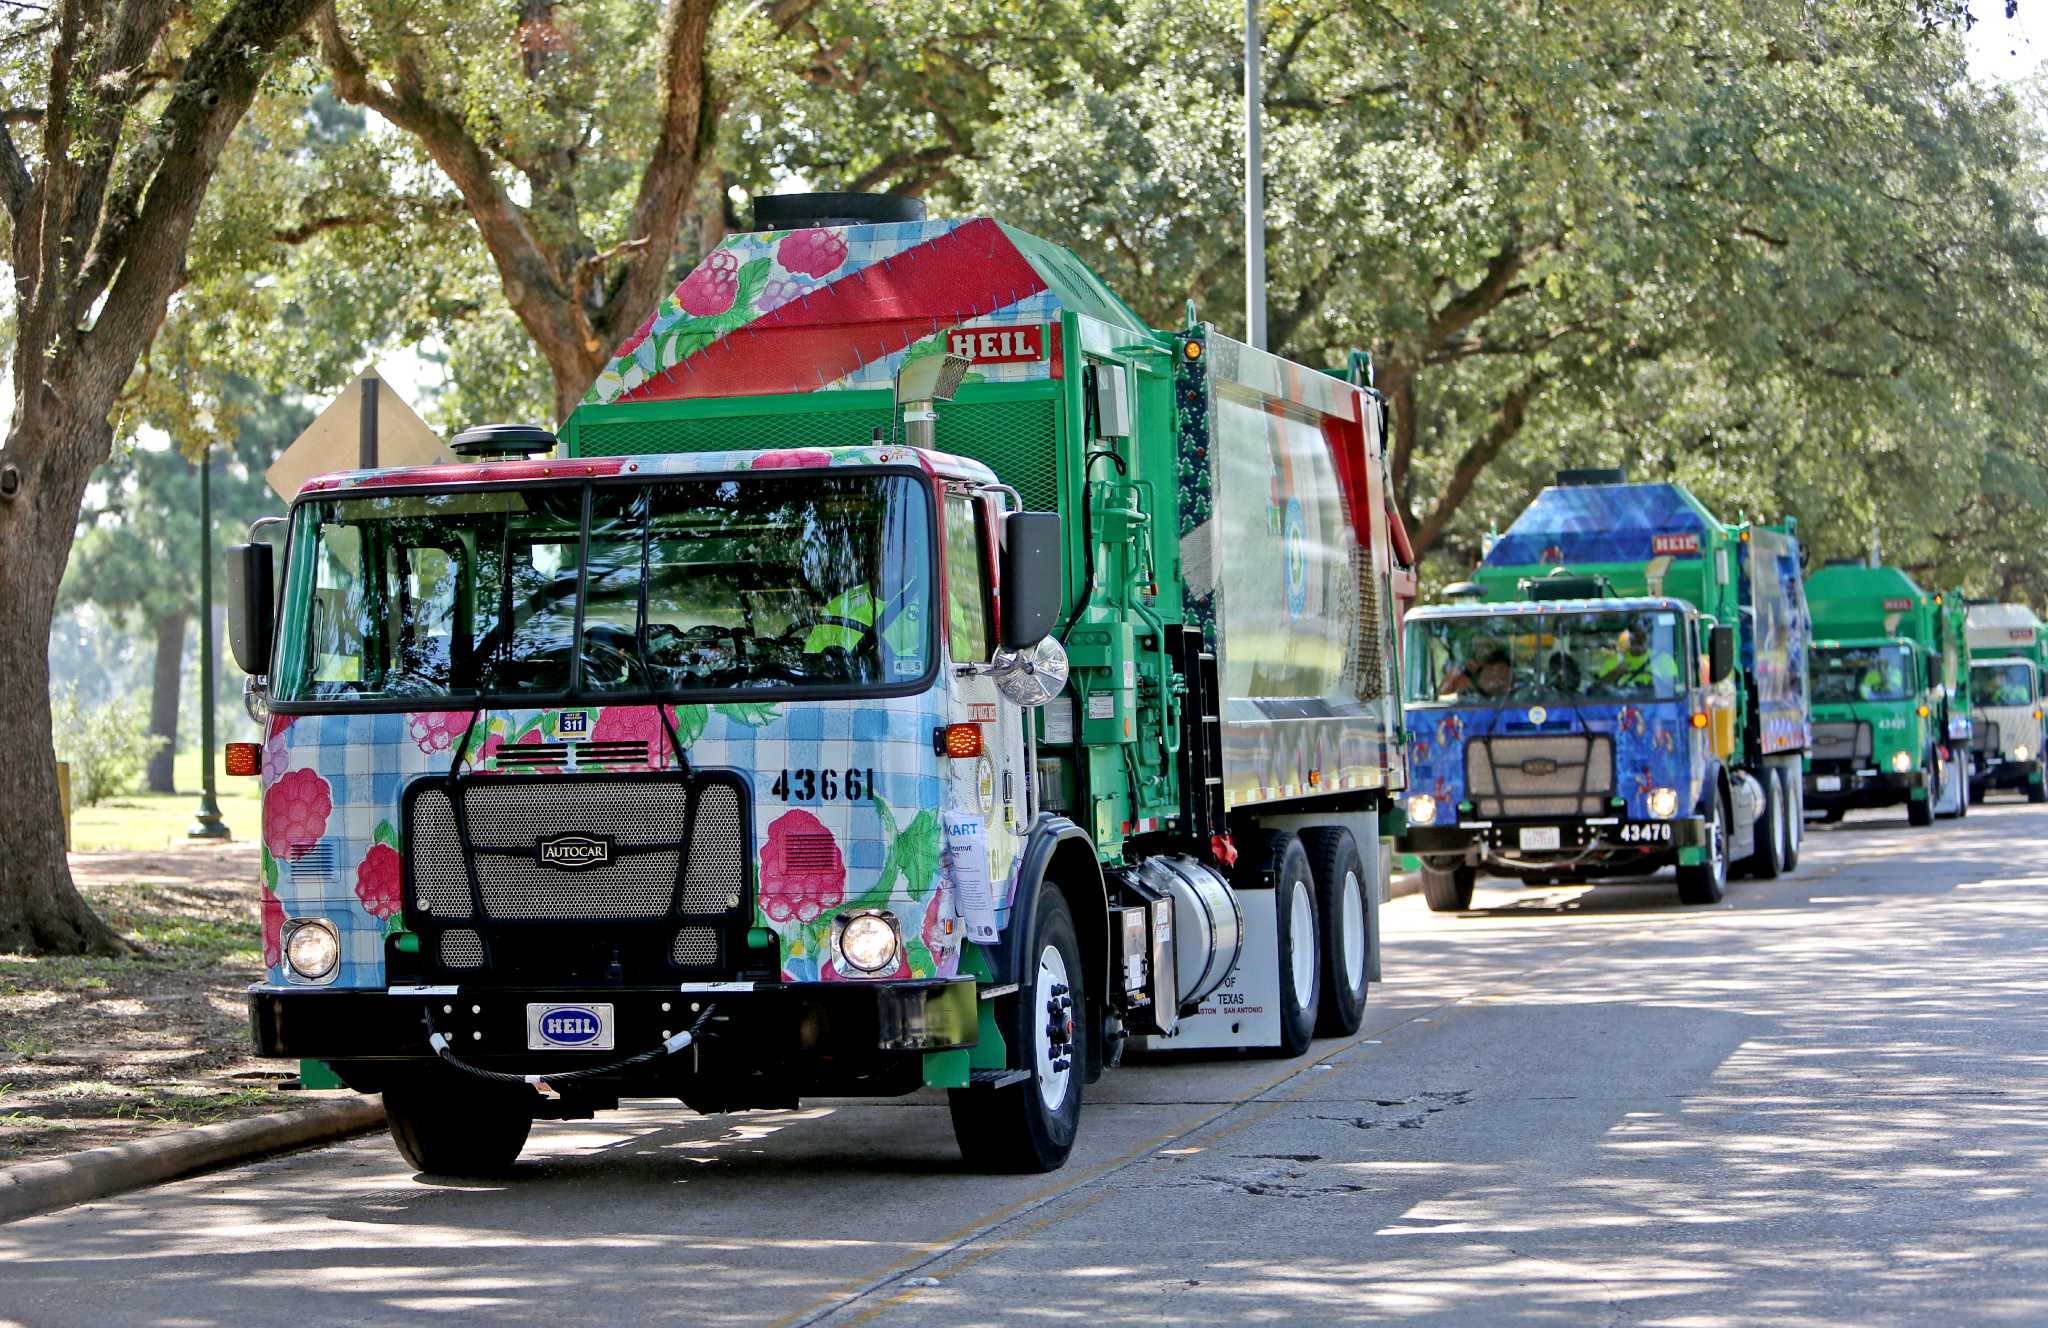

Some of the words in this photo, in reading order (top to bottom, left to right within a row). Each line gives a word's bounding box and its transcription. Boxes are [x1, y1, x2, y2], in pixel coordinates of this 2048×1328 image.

[951, 331, 1035, 359] HEIL
[1656, 537, 1698, 550] HEIL
[564, 719, 583, 730] 311
[772, 768, 874, 802] 43661
[1620, 823, 1671, 841] 43470
[545, 846, 604, 858] AUTOCAR
[1224, 977, 1236, 988] OF
[1217, 993, 1244, 1005] TEXAS
[547, 1018, 596, 1034] HEIL
